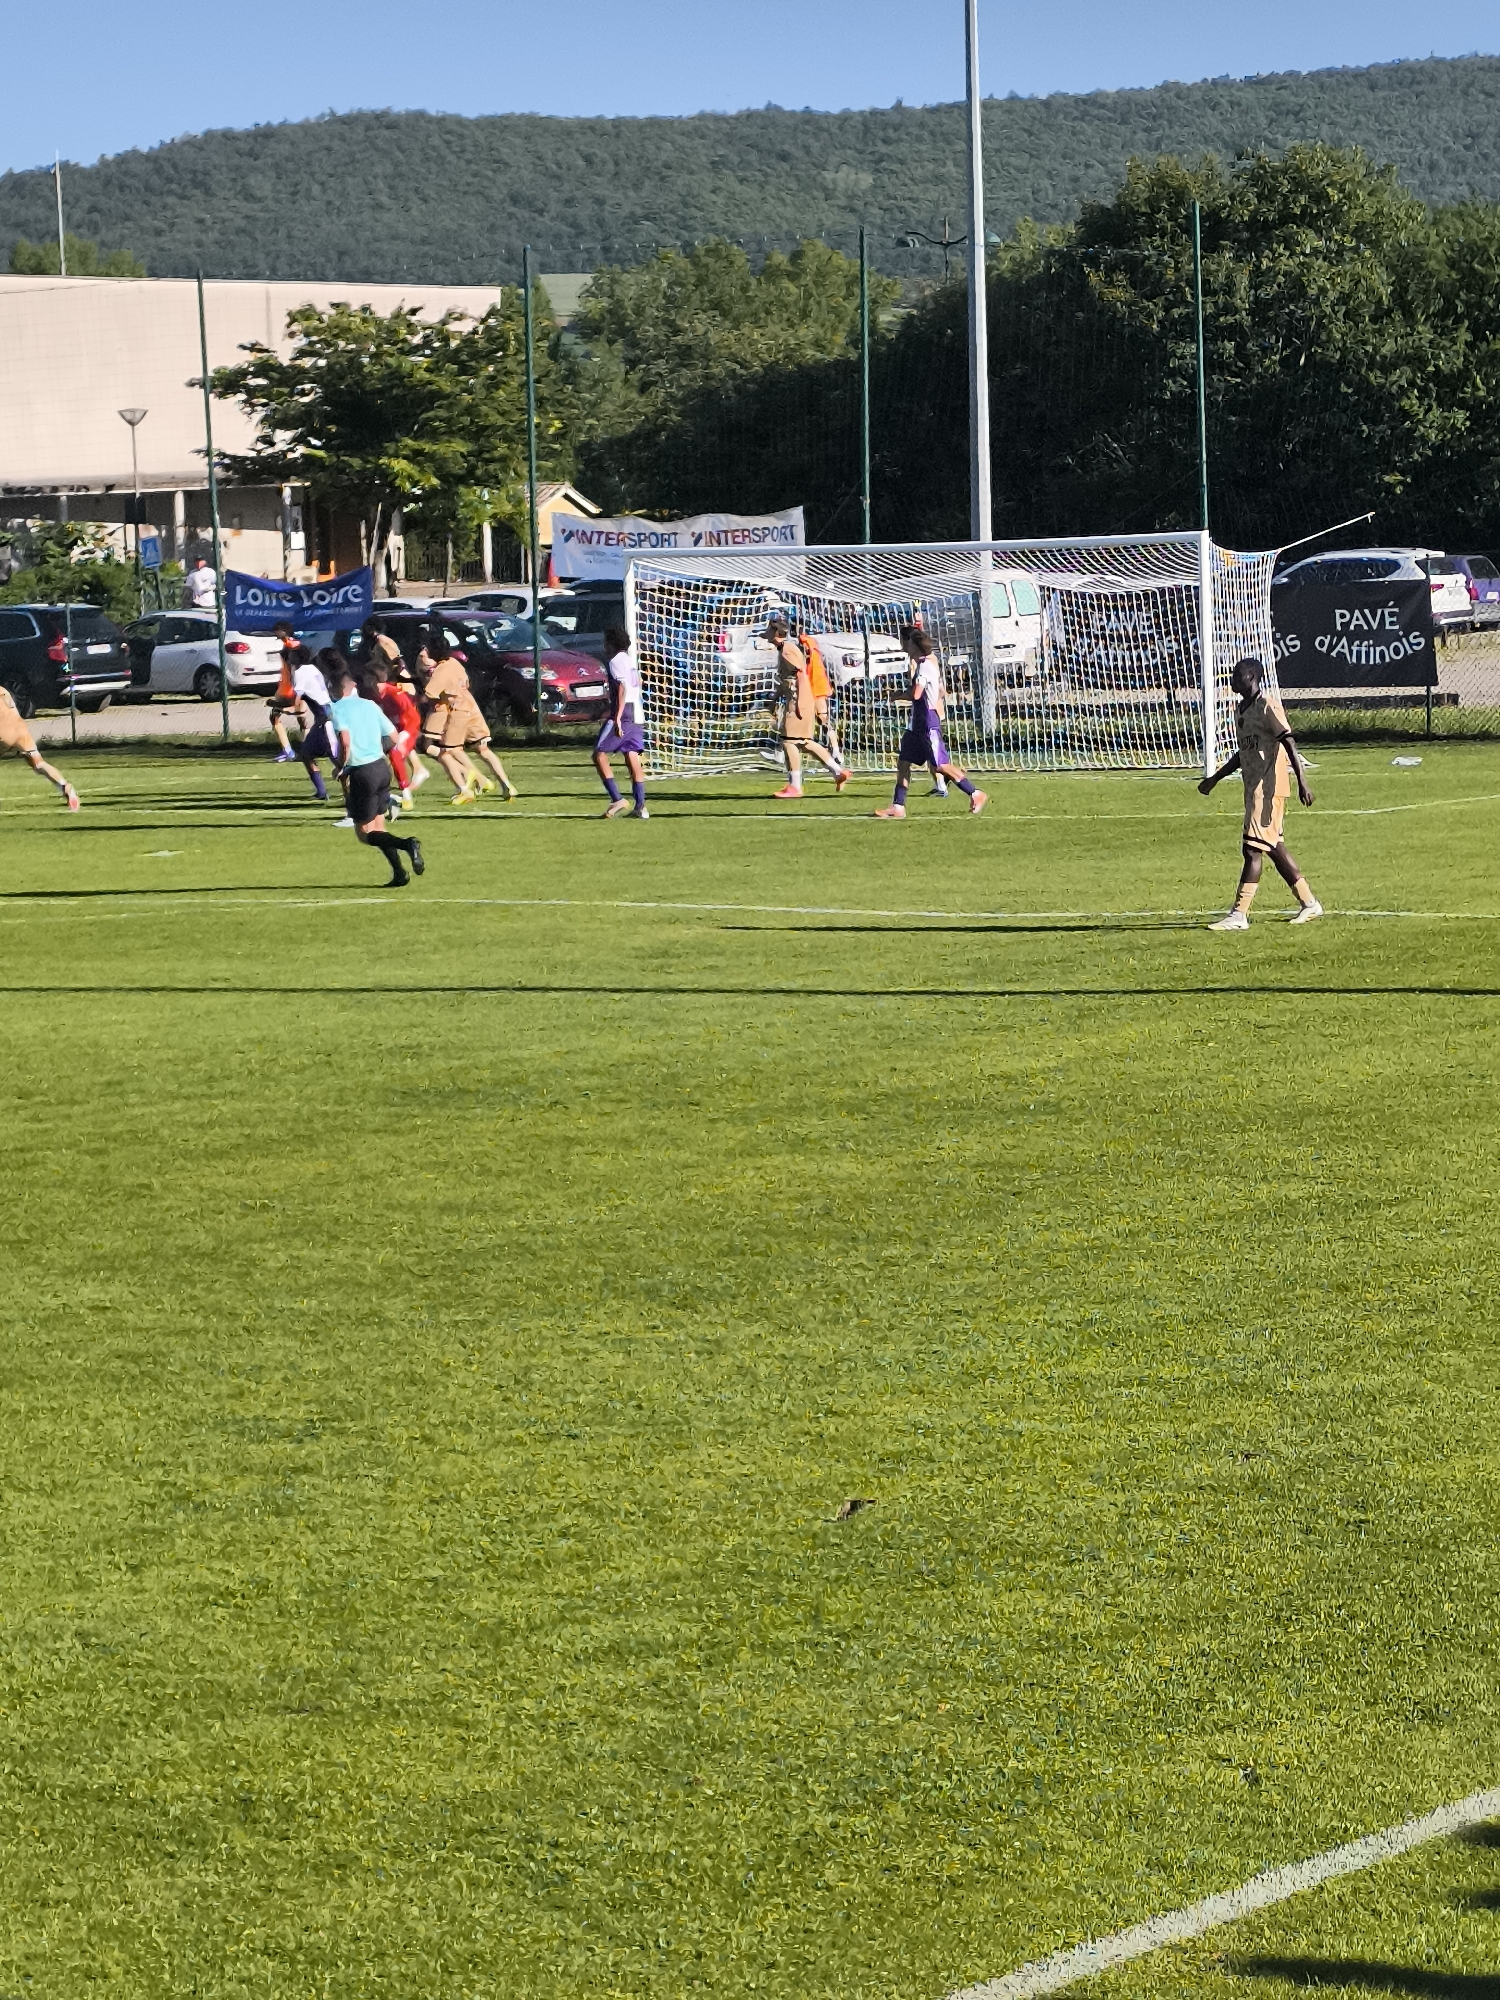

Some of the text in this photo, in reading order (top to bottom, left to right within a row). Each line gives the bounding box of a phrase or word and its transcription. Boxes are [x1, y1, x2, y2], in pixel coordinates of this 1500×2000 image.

[575, 524, 797, 548] INTERSPORT INTERSPORT
[300, 584, 364, 607] Loire
[1334, 601, 1400, 631] PAVÉ
[1314, 631, 1426, 665] d'Affinois
